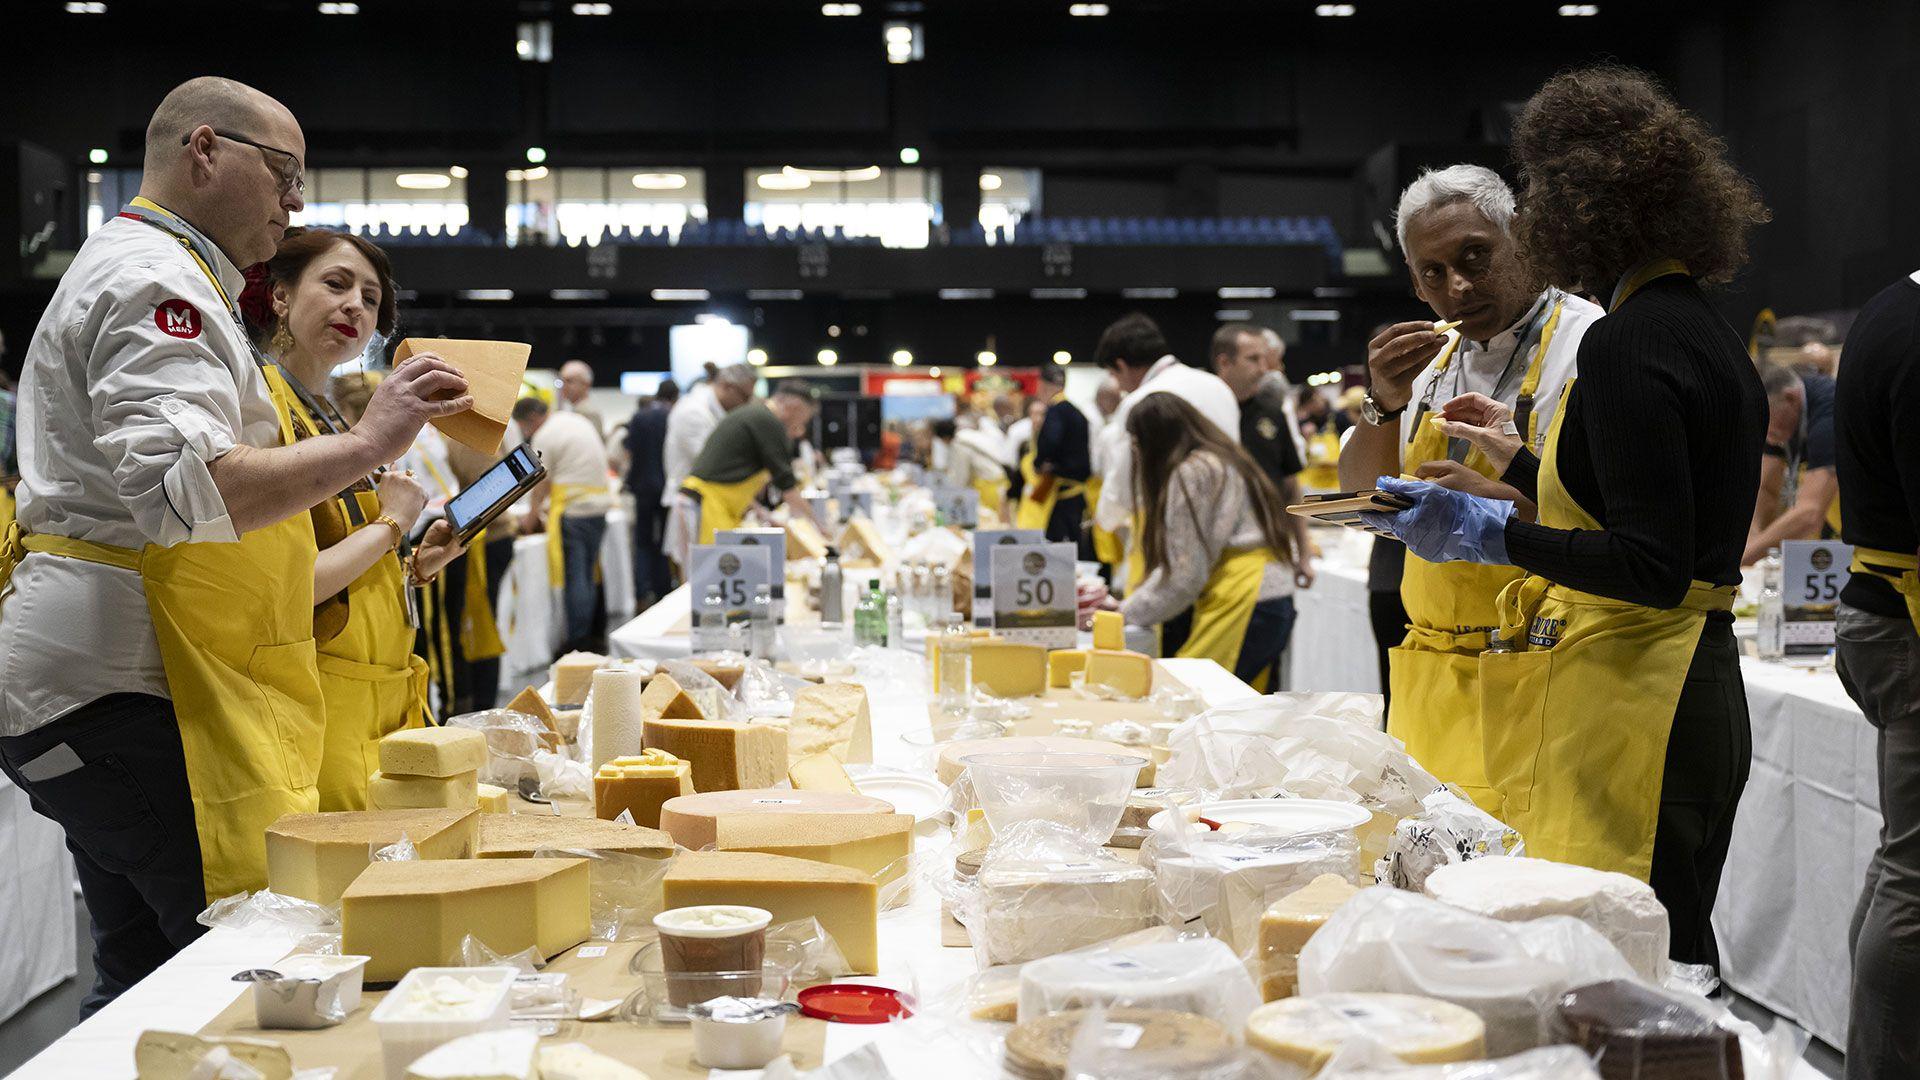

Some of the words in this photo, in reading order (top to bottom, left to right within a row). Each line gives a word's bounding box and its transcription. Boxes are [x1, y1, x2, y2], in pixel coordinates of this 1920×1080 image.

[165, 307, 192, 329] M
[1015, 578, 1054, 606] 50
[1805, 574, 1838, 601] 55
